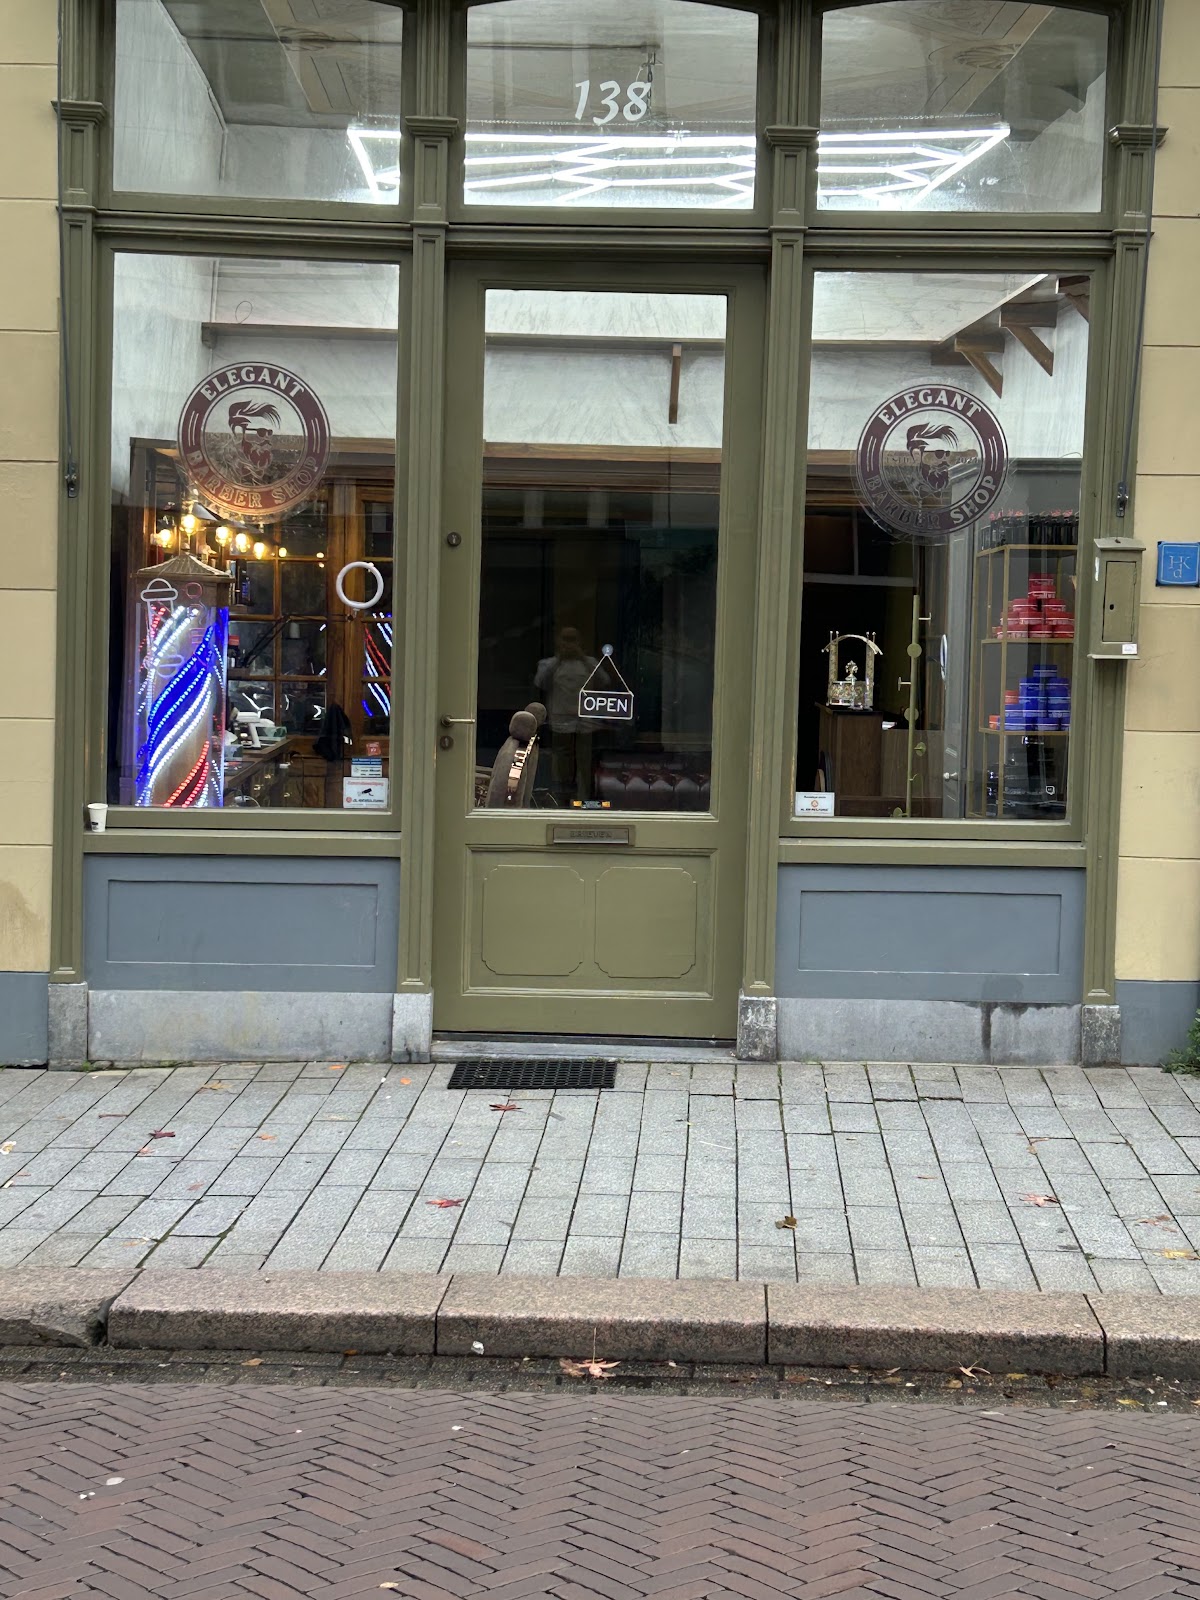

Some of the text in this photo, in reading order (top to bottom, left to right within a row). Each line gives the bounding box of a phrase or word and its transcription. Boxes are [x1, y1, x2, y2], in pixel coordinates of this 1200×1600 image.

[575, 80, 651, 126] 138
[200, 367, 304, 401] ELEGANT
[878, 389, 982, 425] ELEGANT
[186, 450, 318, 508] BARBER SHOP
[865, 474, 997, 530] BARBER SHOP
[584, 696, 628, 713] OPEN
